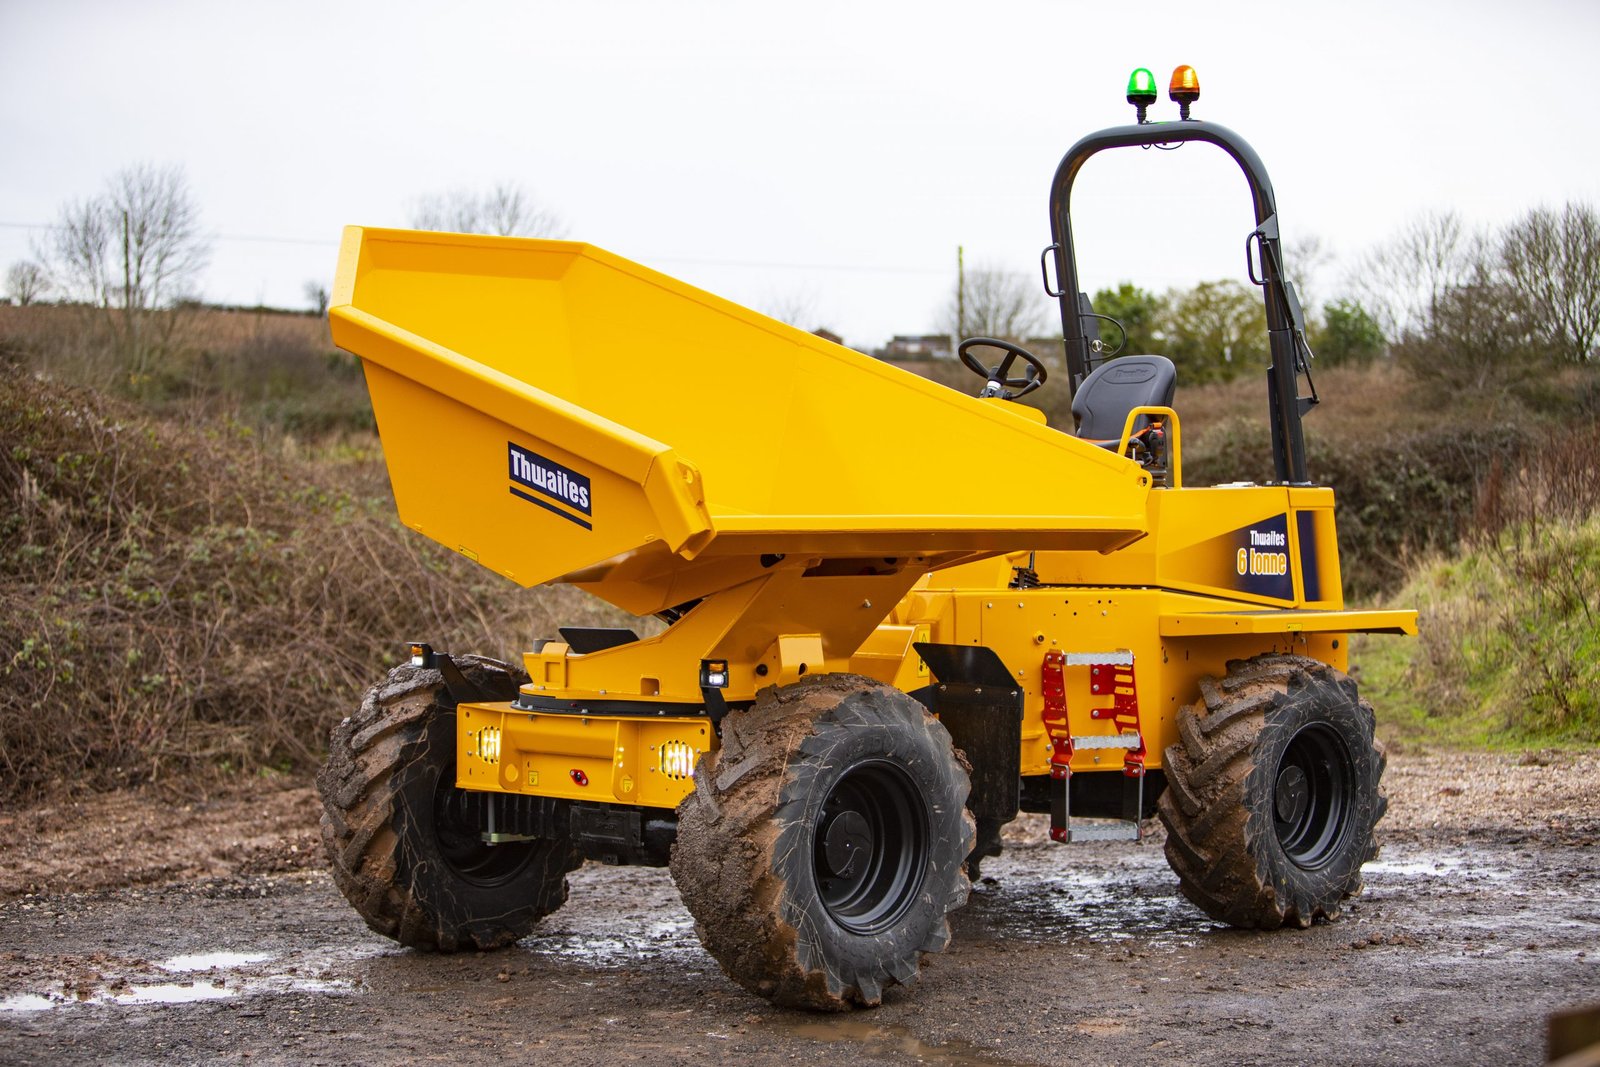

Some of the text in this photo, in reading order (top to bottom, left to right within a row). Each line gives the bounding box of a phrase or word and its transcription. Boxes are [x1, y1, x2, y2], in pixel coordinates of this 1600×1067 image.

[511, 449, 589, 508] Thwaites
[1250, 530, 1285, 546] Thwaites
[1237, 548, 1287, 575] 6 tonne
